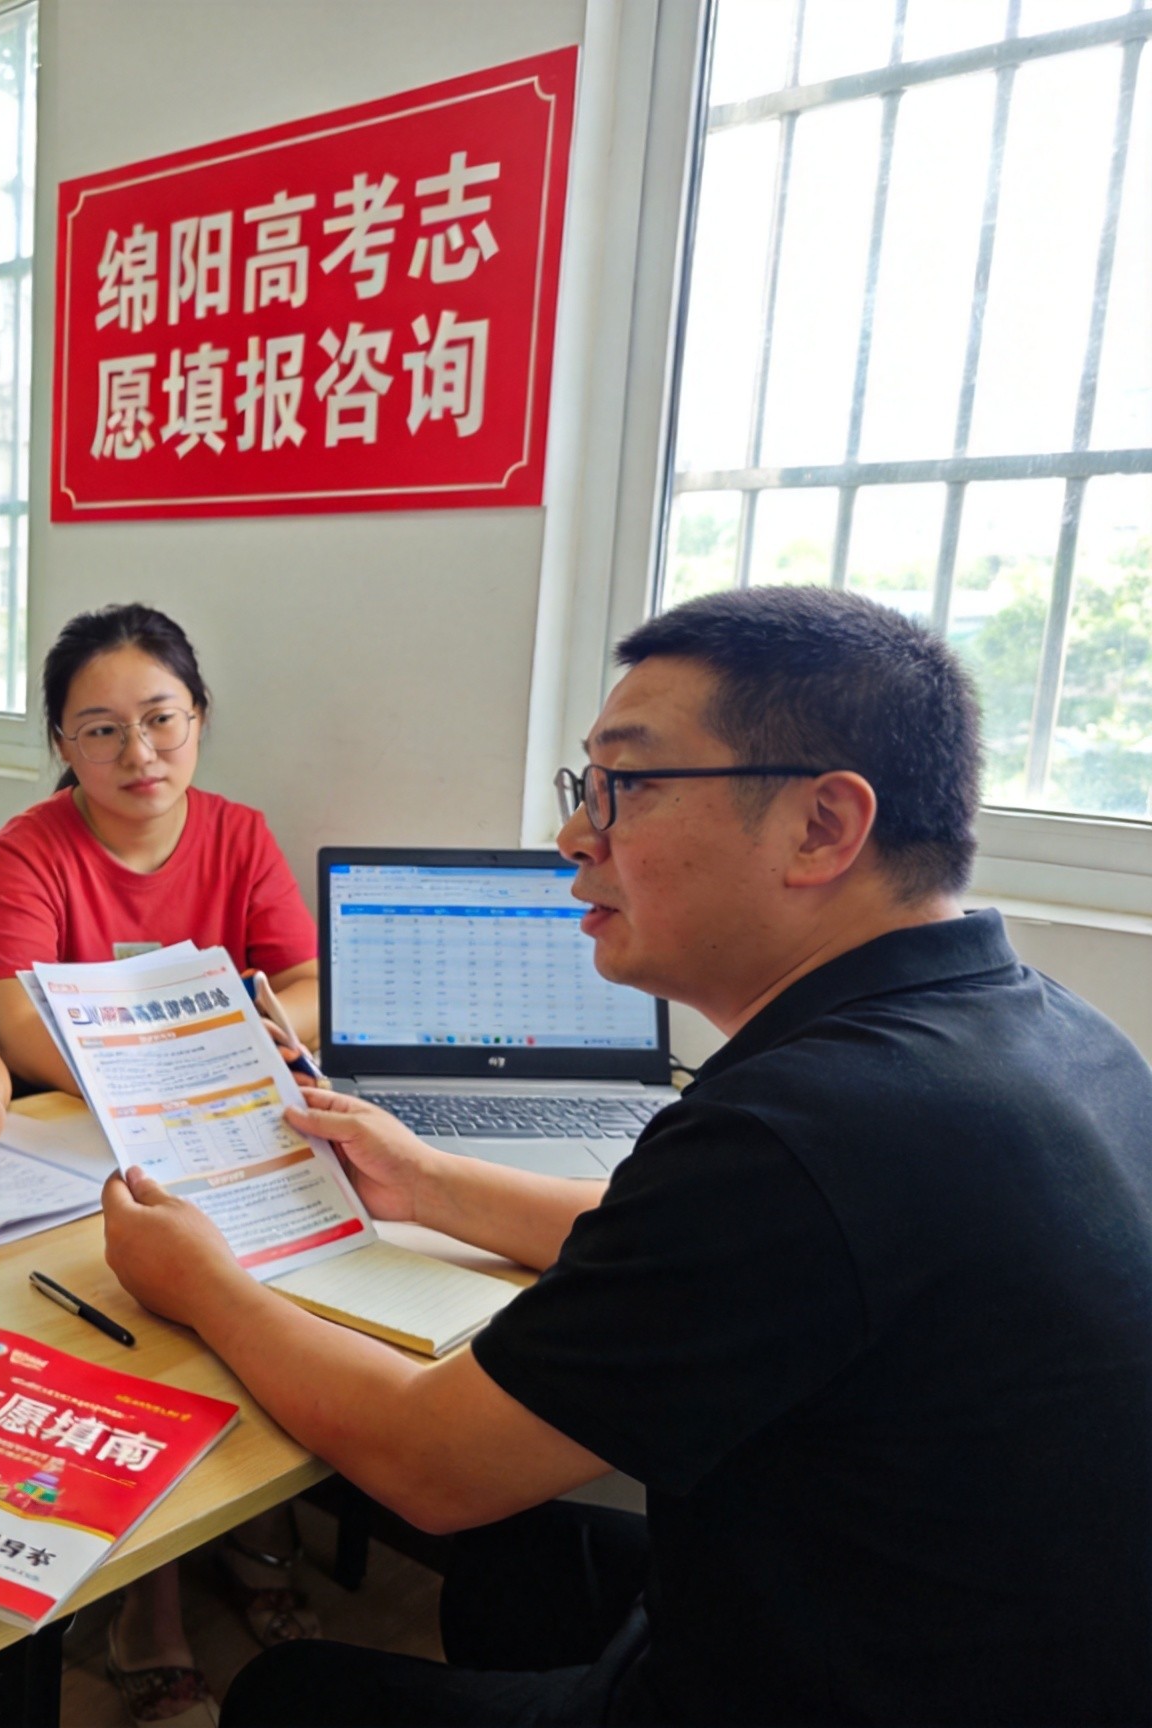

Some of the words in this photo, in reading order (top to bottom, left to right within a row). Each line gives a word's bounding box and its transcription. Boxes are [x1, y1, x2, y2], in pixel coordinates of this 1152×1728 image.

[95, 151, 501, 333] 绵阳高考志
[90, 310, 490, 460] 愿填报咨询
